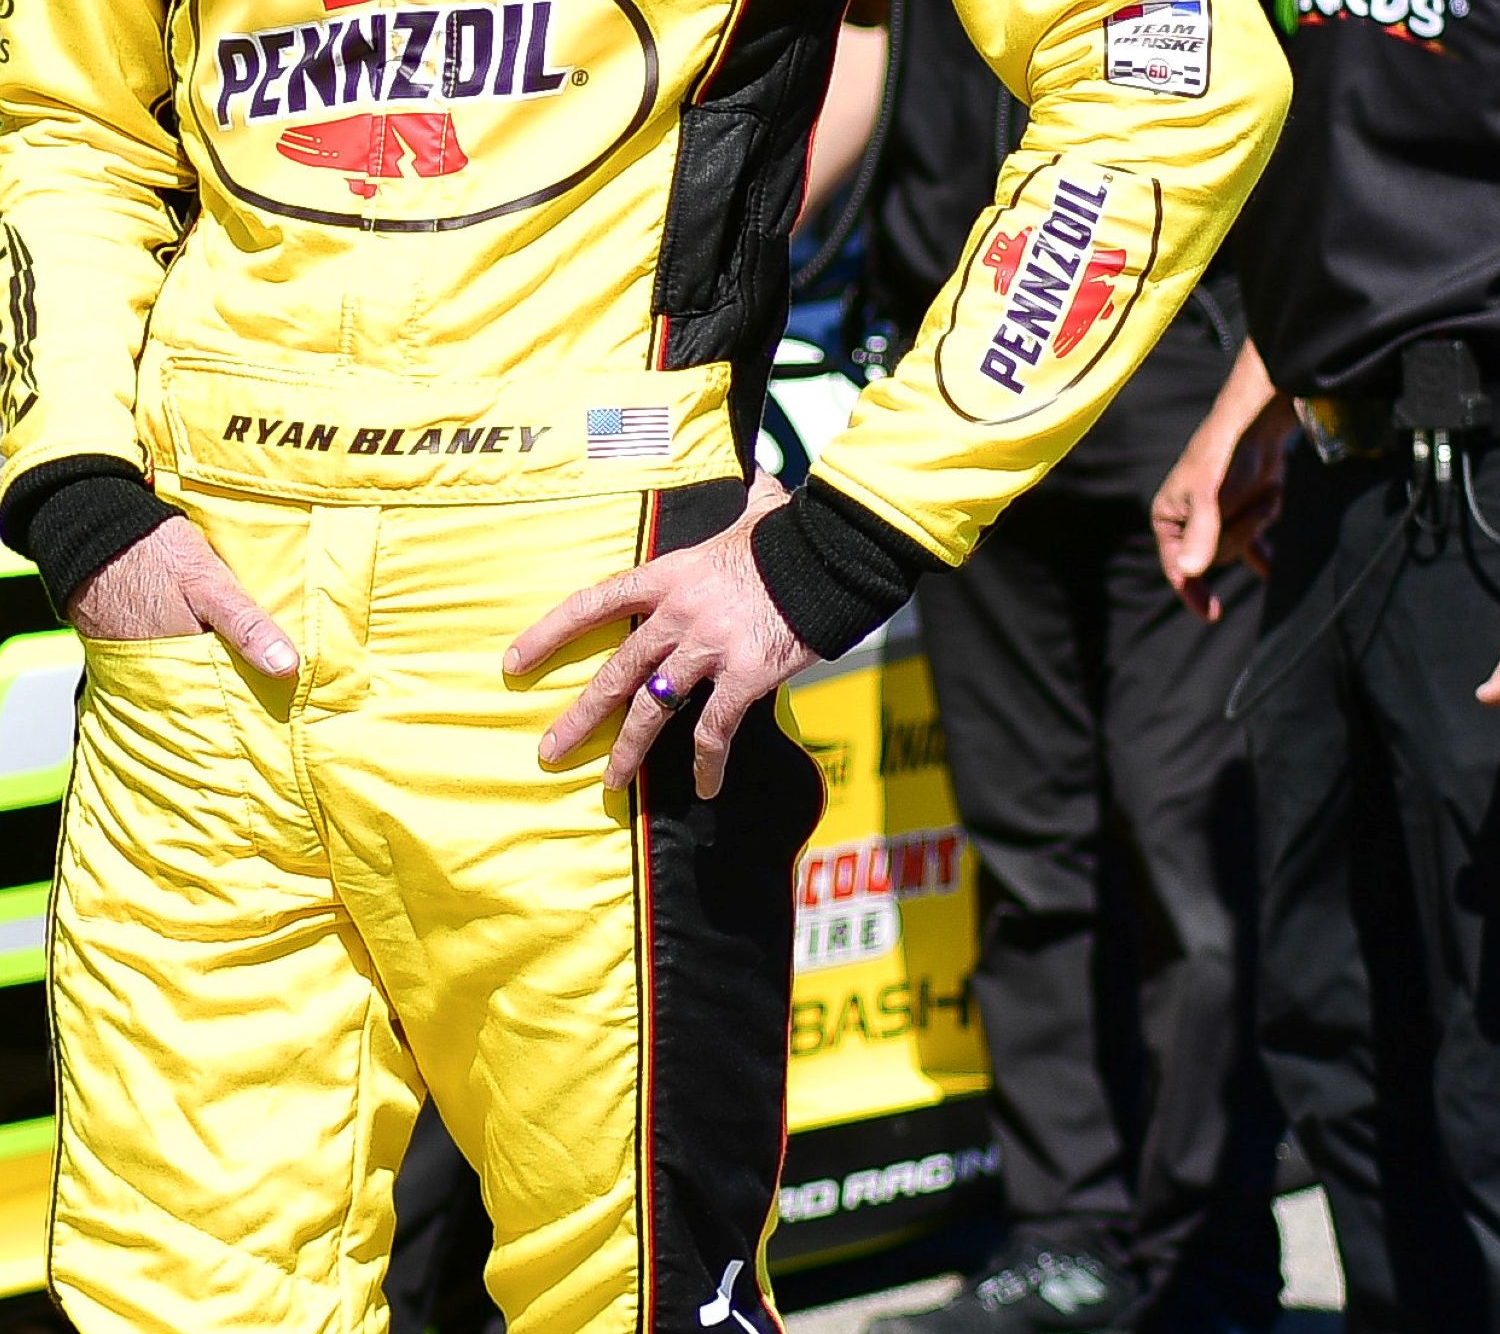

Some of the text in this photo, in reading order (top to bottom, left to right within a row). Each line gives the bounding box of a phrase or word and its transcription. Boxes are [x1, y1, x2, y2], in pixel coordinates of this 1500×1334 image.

[1131, 23, 1198, 36] TEAM
[216, 1, 567, 127] PENNZOIL
[1148, 63, 1169, 80] 60
[980, 178, 1108, 395] PENNZOIL
[222, 414, 553, 457] RYAN BLANEY
[798, 832, 962, 910] COUNT
[798, 911, 883, 962] IRE
[790, 973, 971, 1057] BASH
